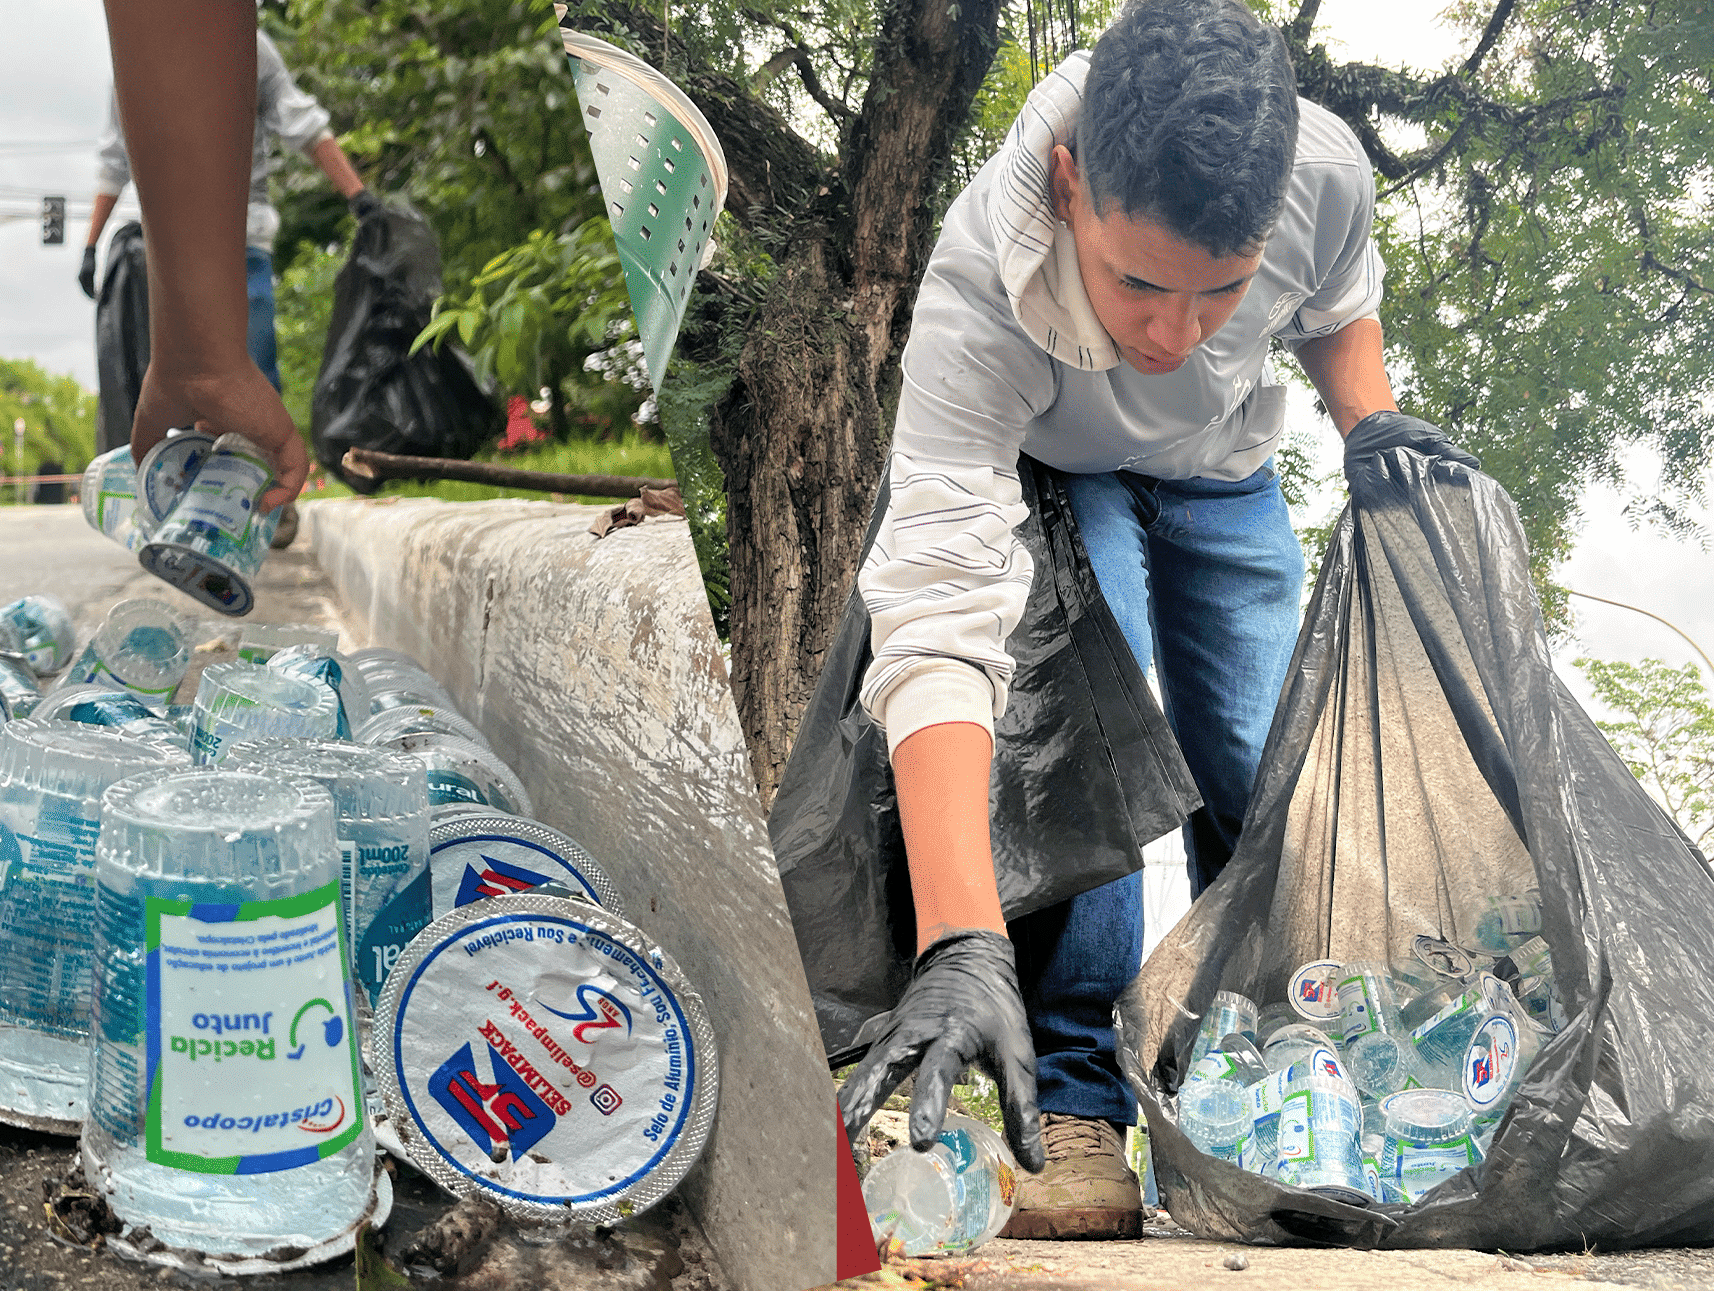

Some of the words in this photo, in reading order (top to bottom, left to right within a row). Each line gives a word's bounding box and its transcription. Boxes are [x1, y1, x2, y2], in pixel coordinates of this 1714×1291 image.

[359, 845, 409, 865] 200ml
[463, 927, 534, 957] Reciclável
[537, 927, 564, 944] Sou
[568, 933, 577, 944] e
[192, 1011, 273, 1035] Junto
[650, 995, 671, 1024] Sou
[170, 1035, 276, 1063] Recicla
[663, 1024, 681, 1092] Alumínio,
[477, 1019, 572, 1116] SELIMPACK
[183, 1098, 333, 1134] Cristalcopo
[658, 1093, 676, 1112] de
[643, 1112, 669, 1142] Selo
